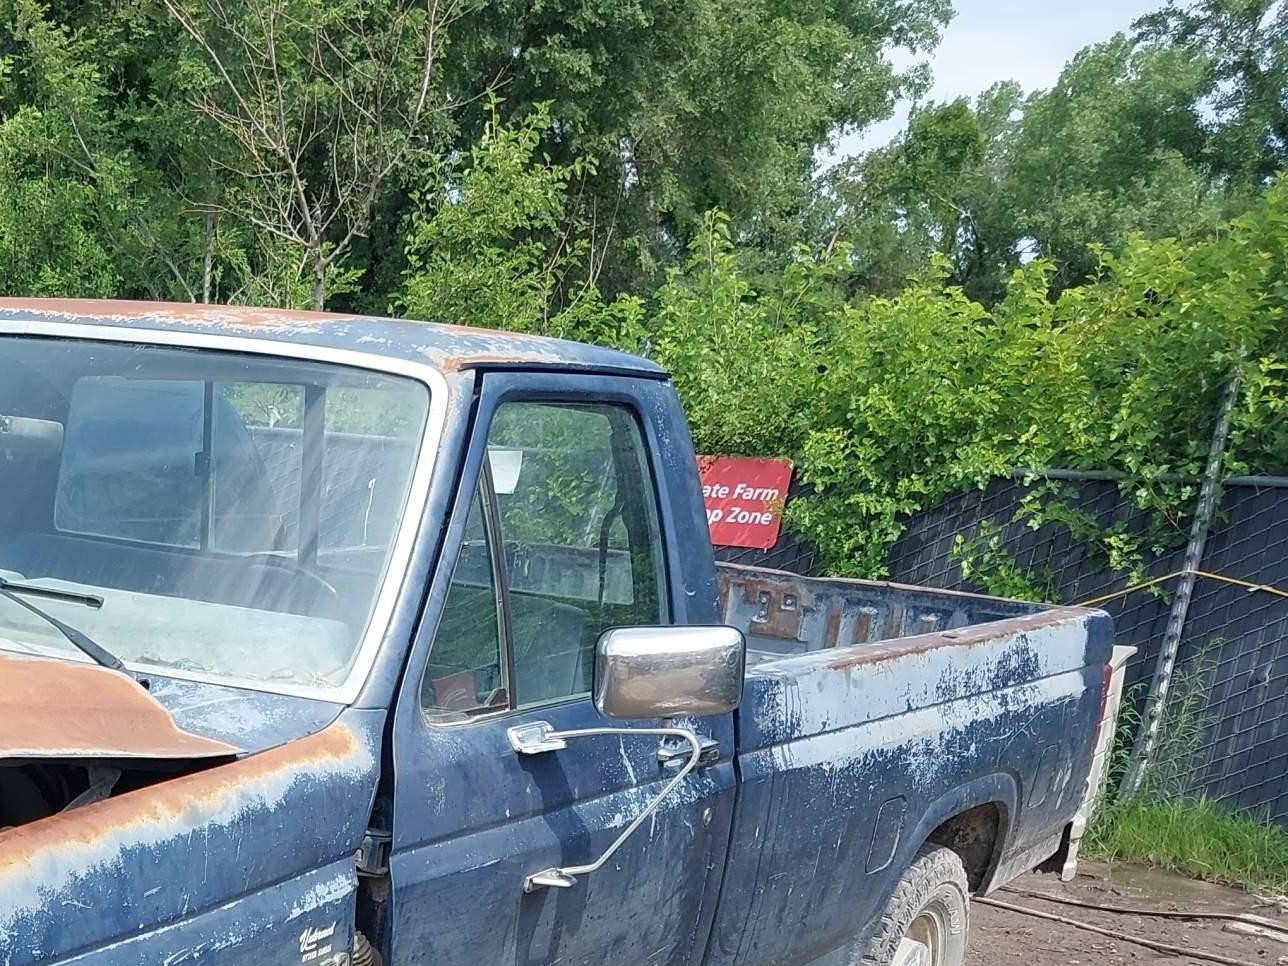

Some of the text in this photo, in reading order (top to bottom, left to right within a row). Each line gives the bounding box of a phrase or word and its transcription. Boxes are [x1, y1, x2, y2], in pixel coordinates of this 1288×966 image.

[702, 483, 779, 501] ate Farm
[725, 506, 773, 525] Zone
